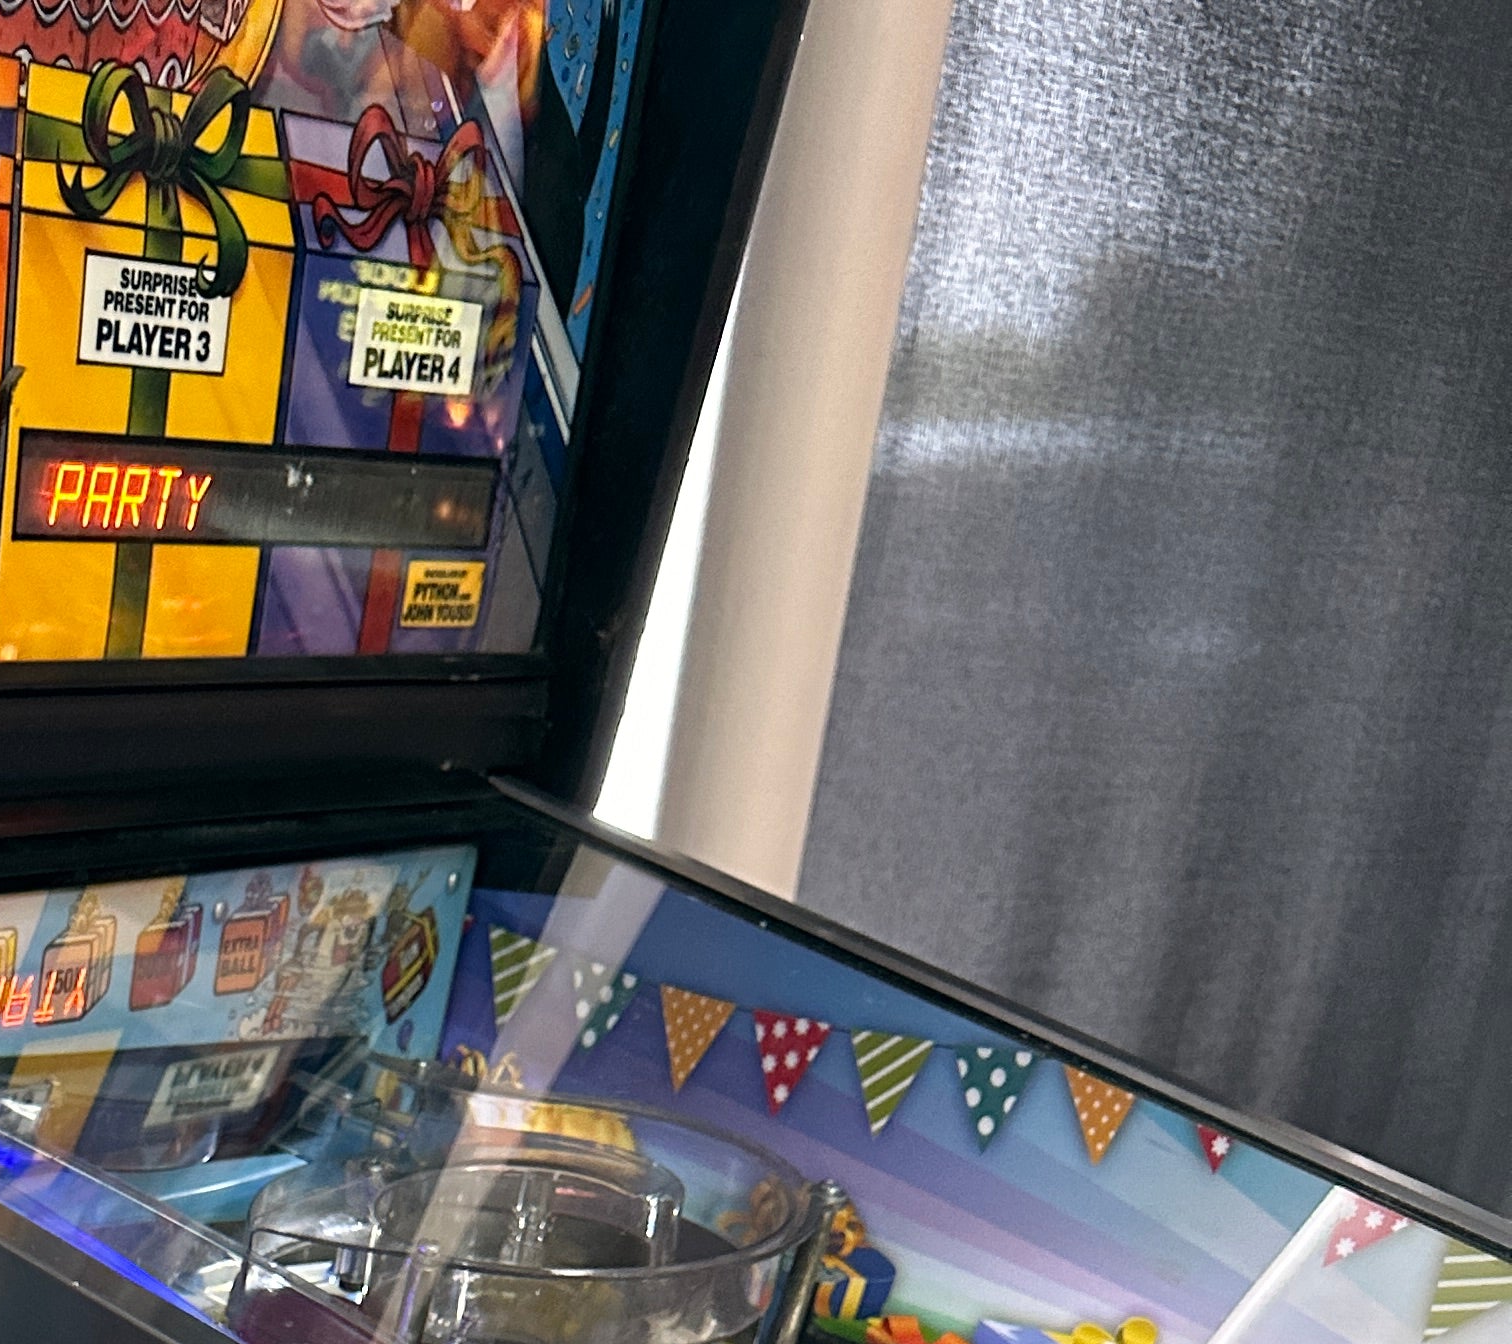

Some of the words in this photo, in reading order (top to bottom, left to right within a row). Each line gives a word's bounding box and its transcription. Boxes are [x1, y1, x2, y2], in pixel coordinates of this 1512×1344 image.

[120, 267, 197, 298] SURPRISE
[103, 290, 176, 318] PRESENT
[178, 300, 210, 323] FOR
[385, 302, 453, 327] SURPRISE
[96, 318, 191, 361] PLAYER
[196, 331, 211, 362] 3
[371, 321, 434, 346] PRESENT
[434, 328, 462, 349] FOR
[363, 347, 445, 384] PLAYER
[447, 356, 461, 386] 4
[47, 461, 213, 531] PARTY
